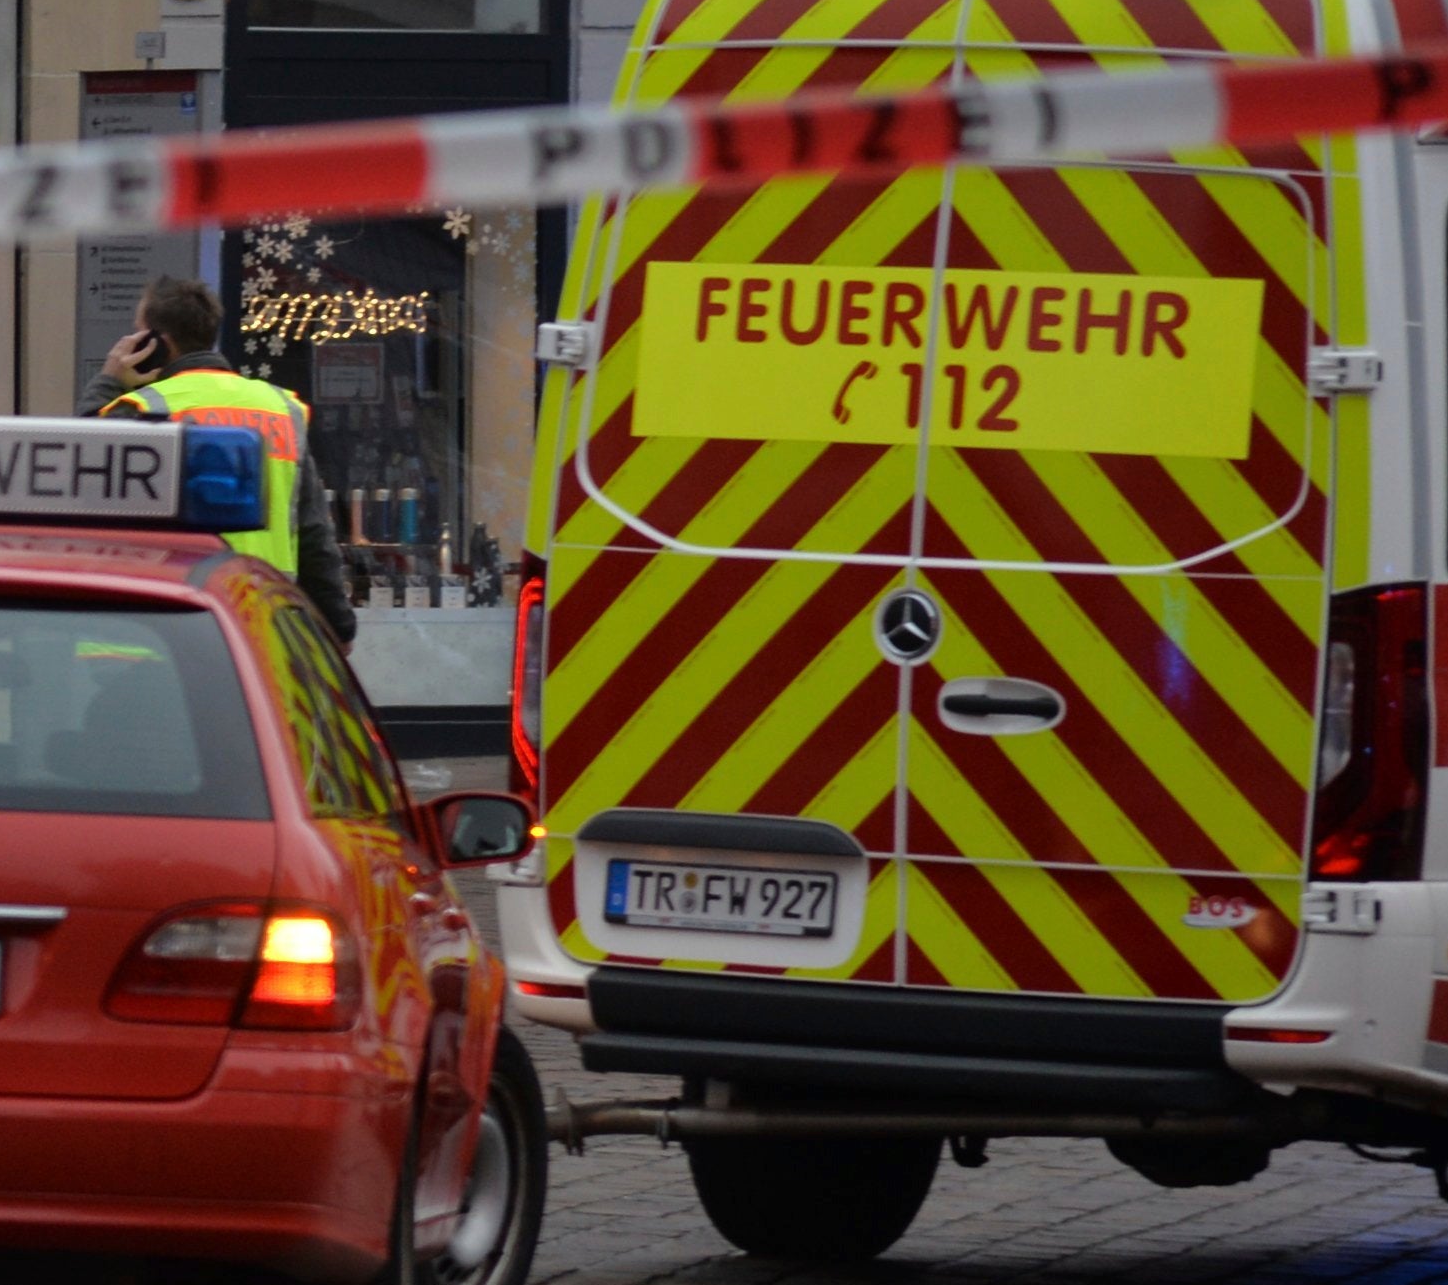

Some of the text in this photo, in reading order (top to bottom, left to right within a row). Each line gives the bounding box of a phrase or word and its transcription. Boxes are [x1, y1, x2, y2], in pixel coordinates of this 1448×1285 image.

[529, 85, 1060, 193] POLIZEI
[694, 275, 1191, 360] FEUERWEHR
[899, 361, 1021, 432] 112
[632, 869, 829, 921] TR FW 927
[1189, 894, 1247, 919] BOS
